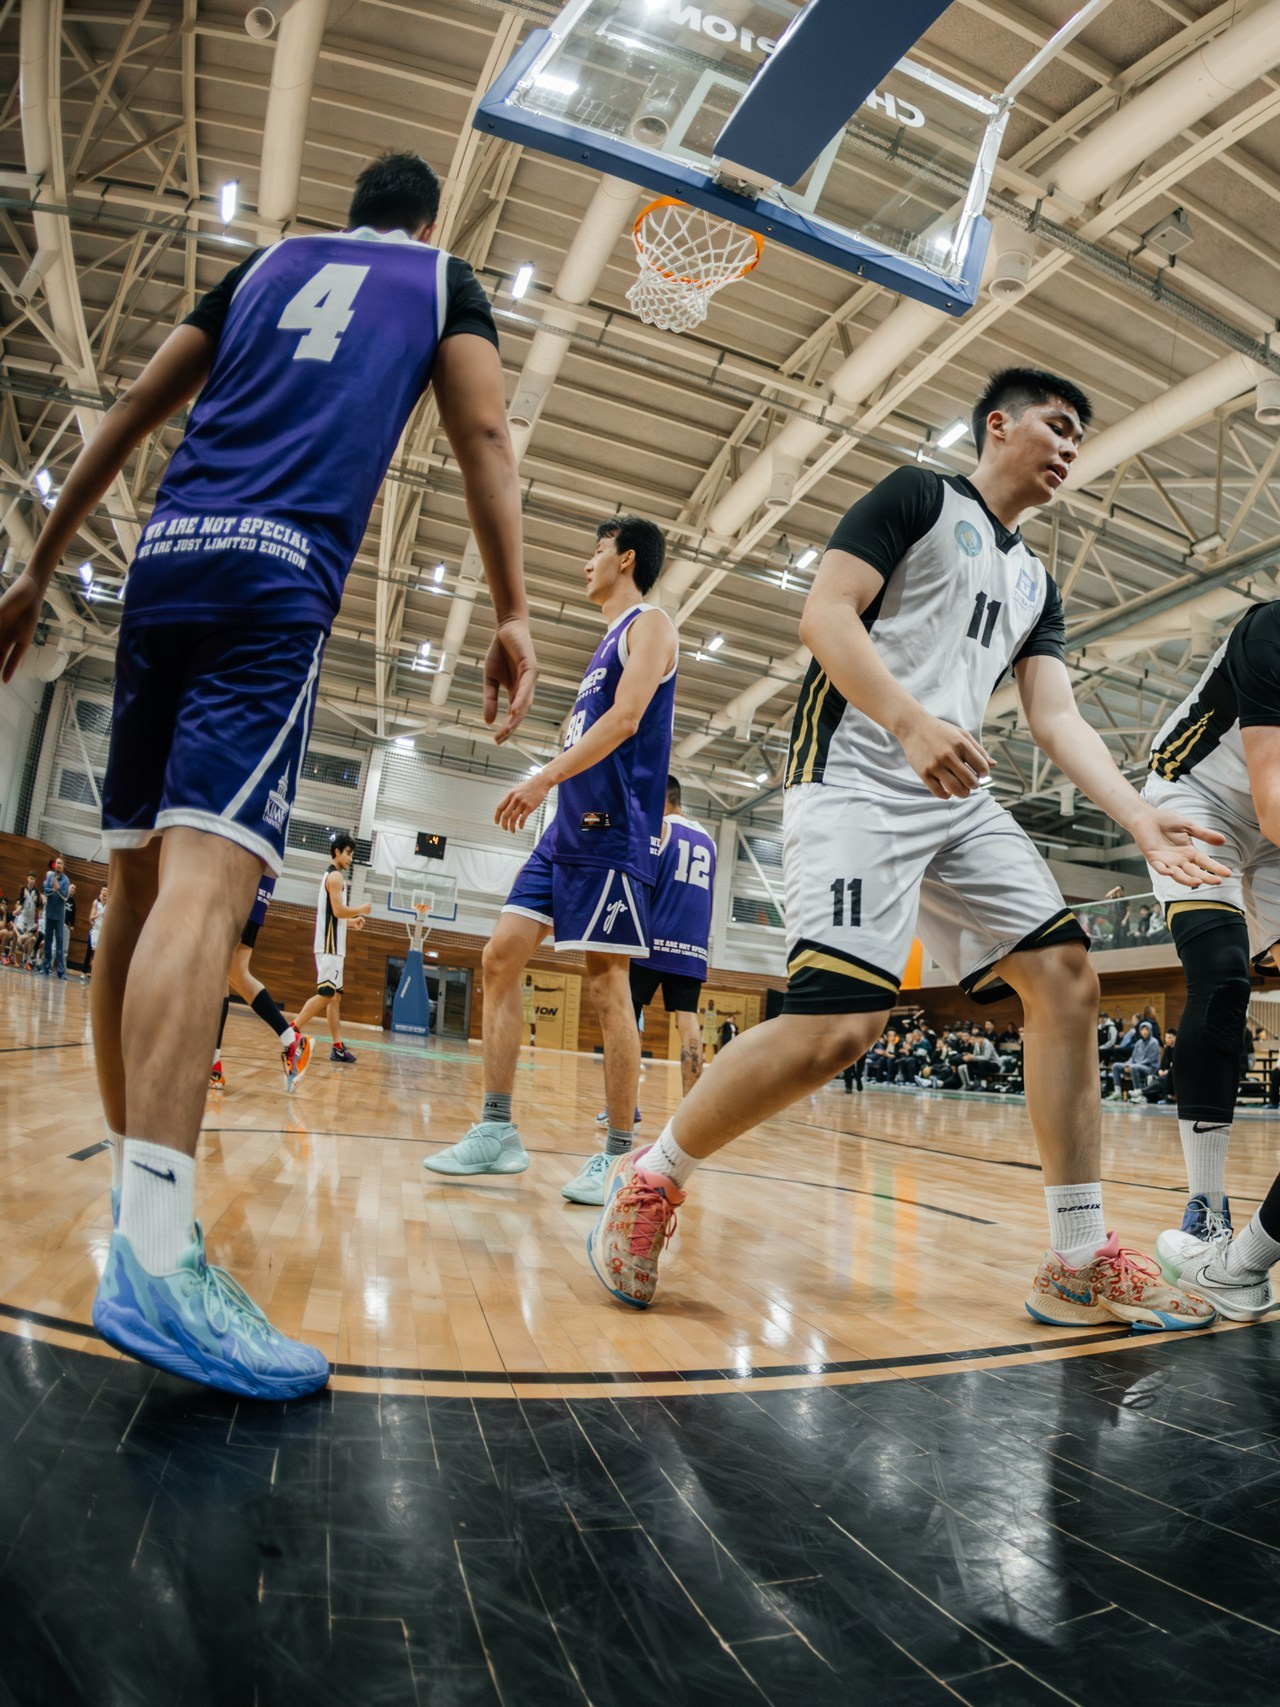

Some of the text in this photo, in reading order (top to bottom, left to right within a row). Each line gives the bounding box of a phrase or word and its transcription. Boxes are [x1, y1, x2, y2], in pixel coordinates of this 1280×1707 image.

[277, 263, 371, 362] 4
[138, 536, 307, 571] WE ARE JUST LIMITED EDITION
[144, 516, 311, 556] WE ARE NOT SPECIAL
[966, 590, 1002, 649] 11
[674, 839, 710, 890] 12
[830, 878, 863, 928] 11
[1057, 1203, 1101, 1213] DEMIX
